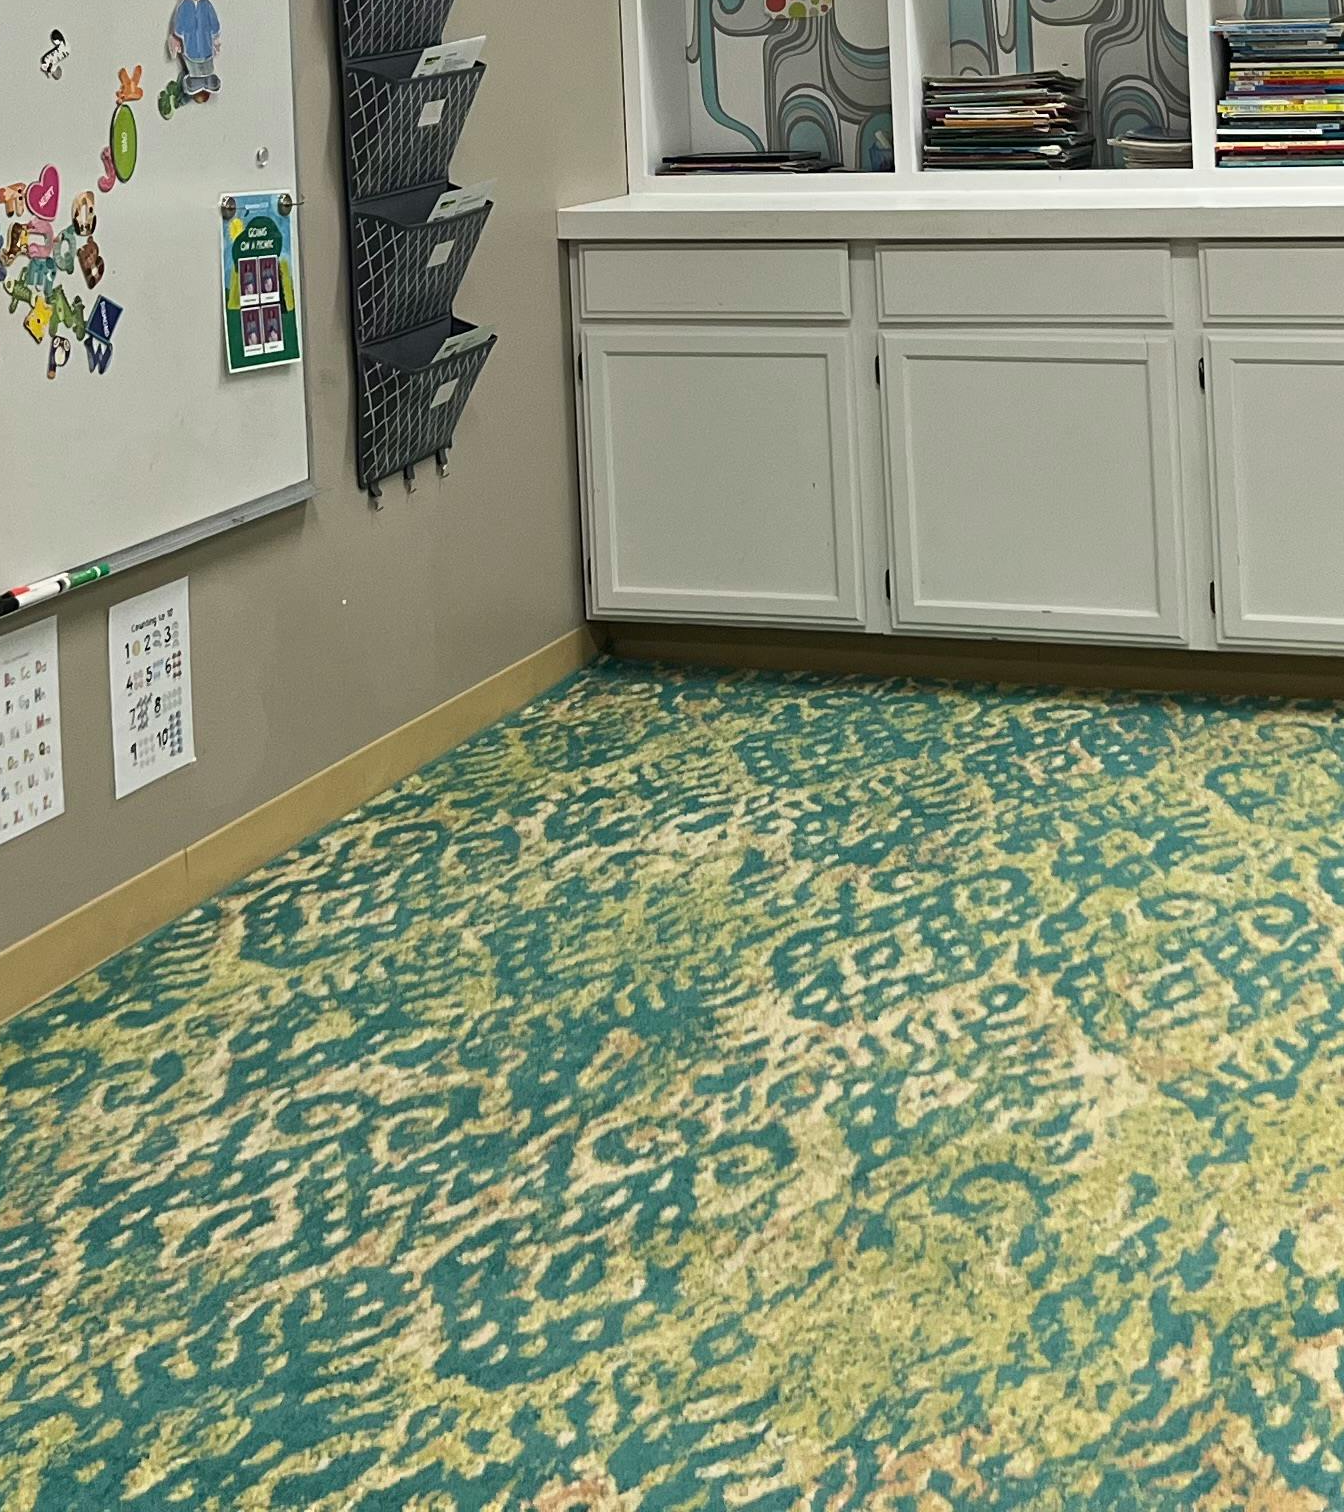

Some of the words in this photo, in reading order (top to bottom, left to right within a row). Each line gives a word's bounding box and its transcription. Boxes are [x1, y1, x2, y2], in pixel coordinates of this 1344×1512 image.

[248, 226, 268, 238] GOING
[124, 642, 131, 659] 1
[143, 634, 152, 653] 2
[163, 625, 172, 643] 3
[126, 675, 134, 692] 4
[145, 665, 153, 683] 5
[164, 656, 172, 674] 6
[128, 707, 136, 726] 7
[153, 696, 161, 714] 8
[130, 741, 138, 761] 9
[156, 726, 170, 750] 10
